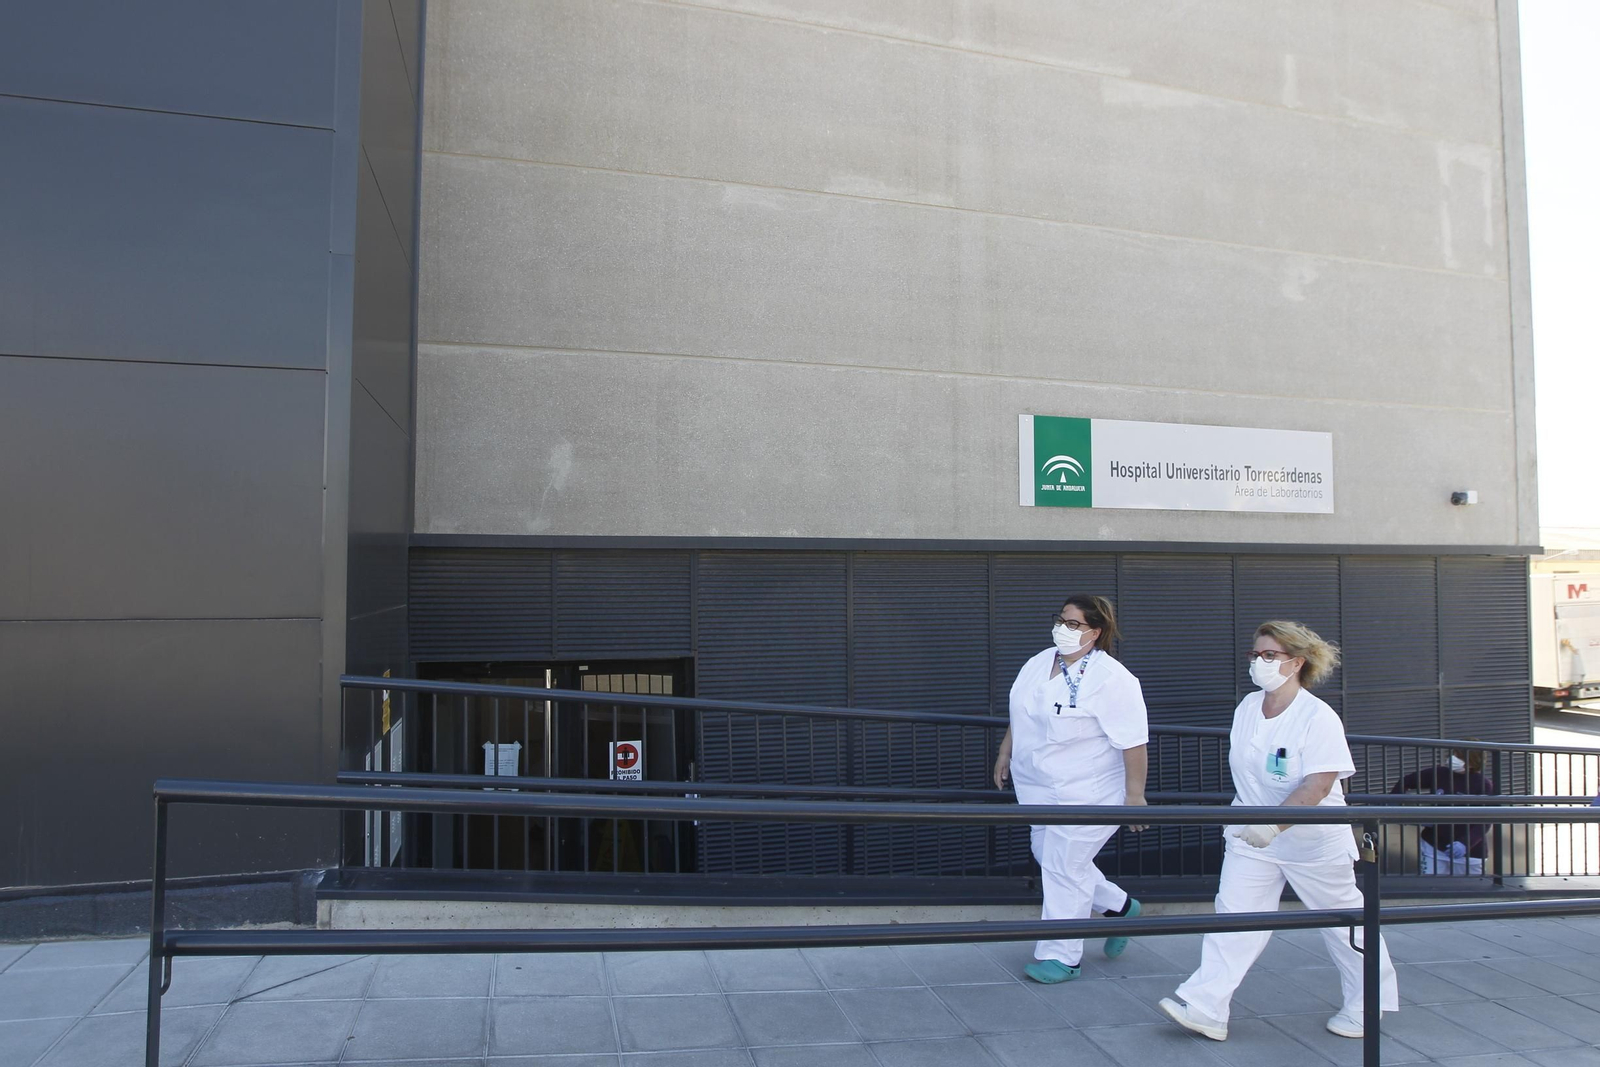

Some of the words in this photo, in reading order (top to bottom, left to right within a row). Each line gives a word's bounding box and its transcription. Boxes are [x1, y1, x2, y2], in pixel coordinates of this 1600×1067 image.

[1110, 460, 1161, 482] Hospital
[1166, 462, 1241, 481] Universitario
[1244, 465, 1323, 484] Torrecárdenas
[1234, 482, 1255, 497] Área
[1257, 486, 1268, 497] de
[1270, 485, 1323, 499] Laboratorios
